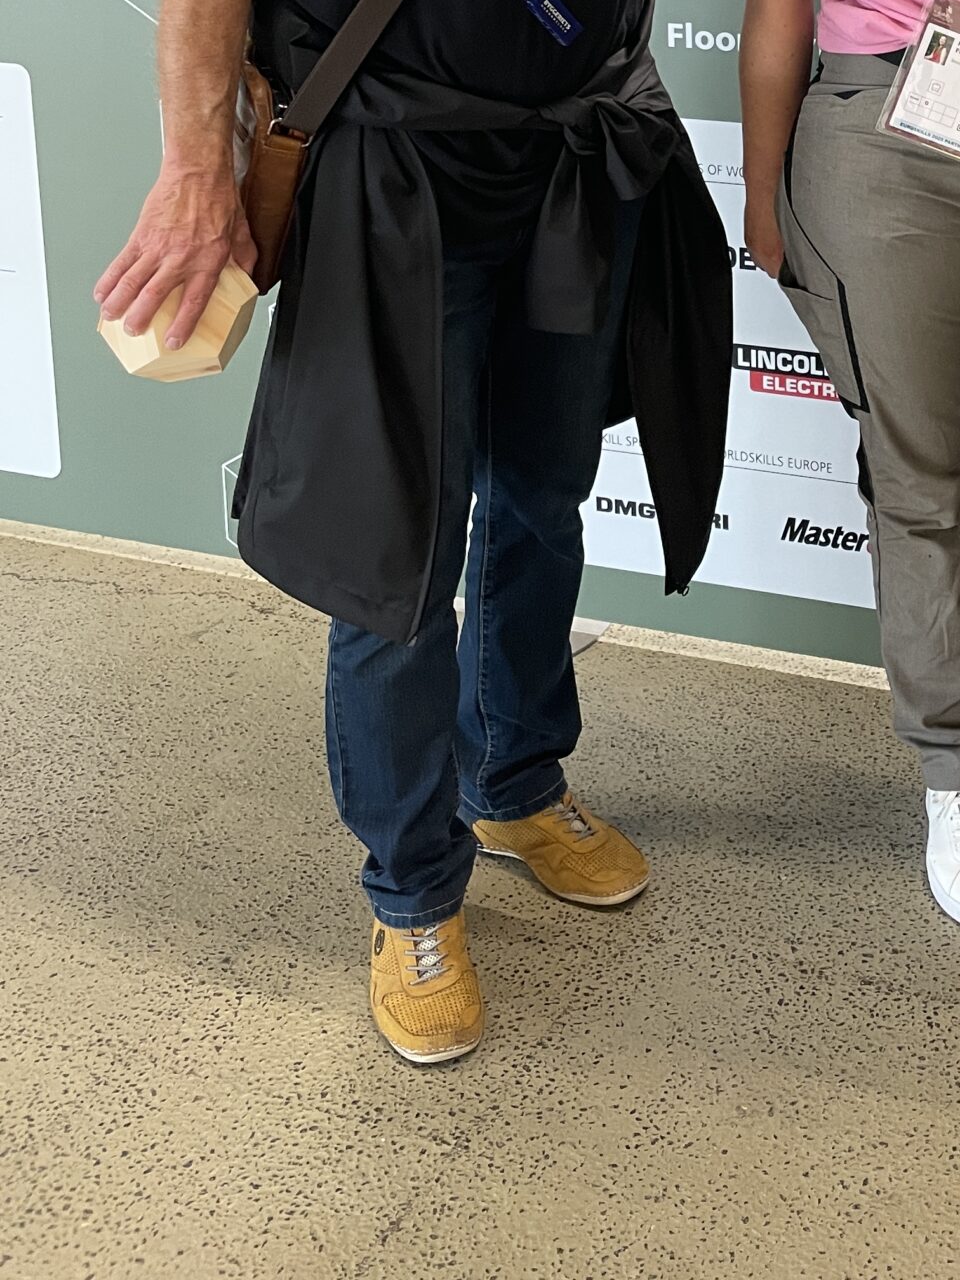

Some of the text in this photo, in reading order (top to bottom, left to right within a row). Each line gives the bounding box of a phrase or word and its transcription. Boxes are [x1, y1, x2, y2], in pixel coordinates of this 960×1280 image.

[707, 164, 722, 176] OF
[737, 347, 828, 377] LINCOL
[762, 375, 840, 399] ELECTR
[724, 449, 833, 474] RLDSKILLS EUROPE
[595, 496, 656, 519] DMG
[780, 517, 870, 553] Master
